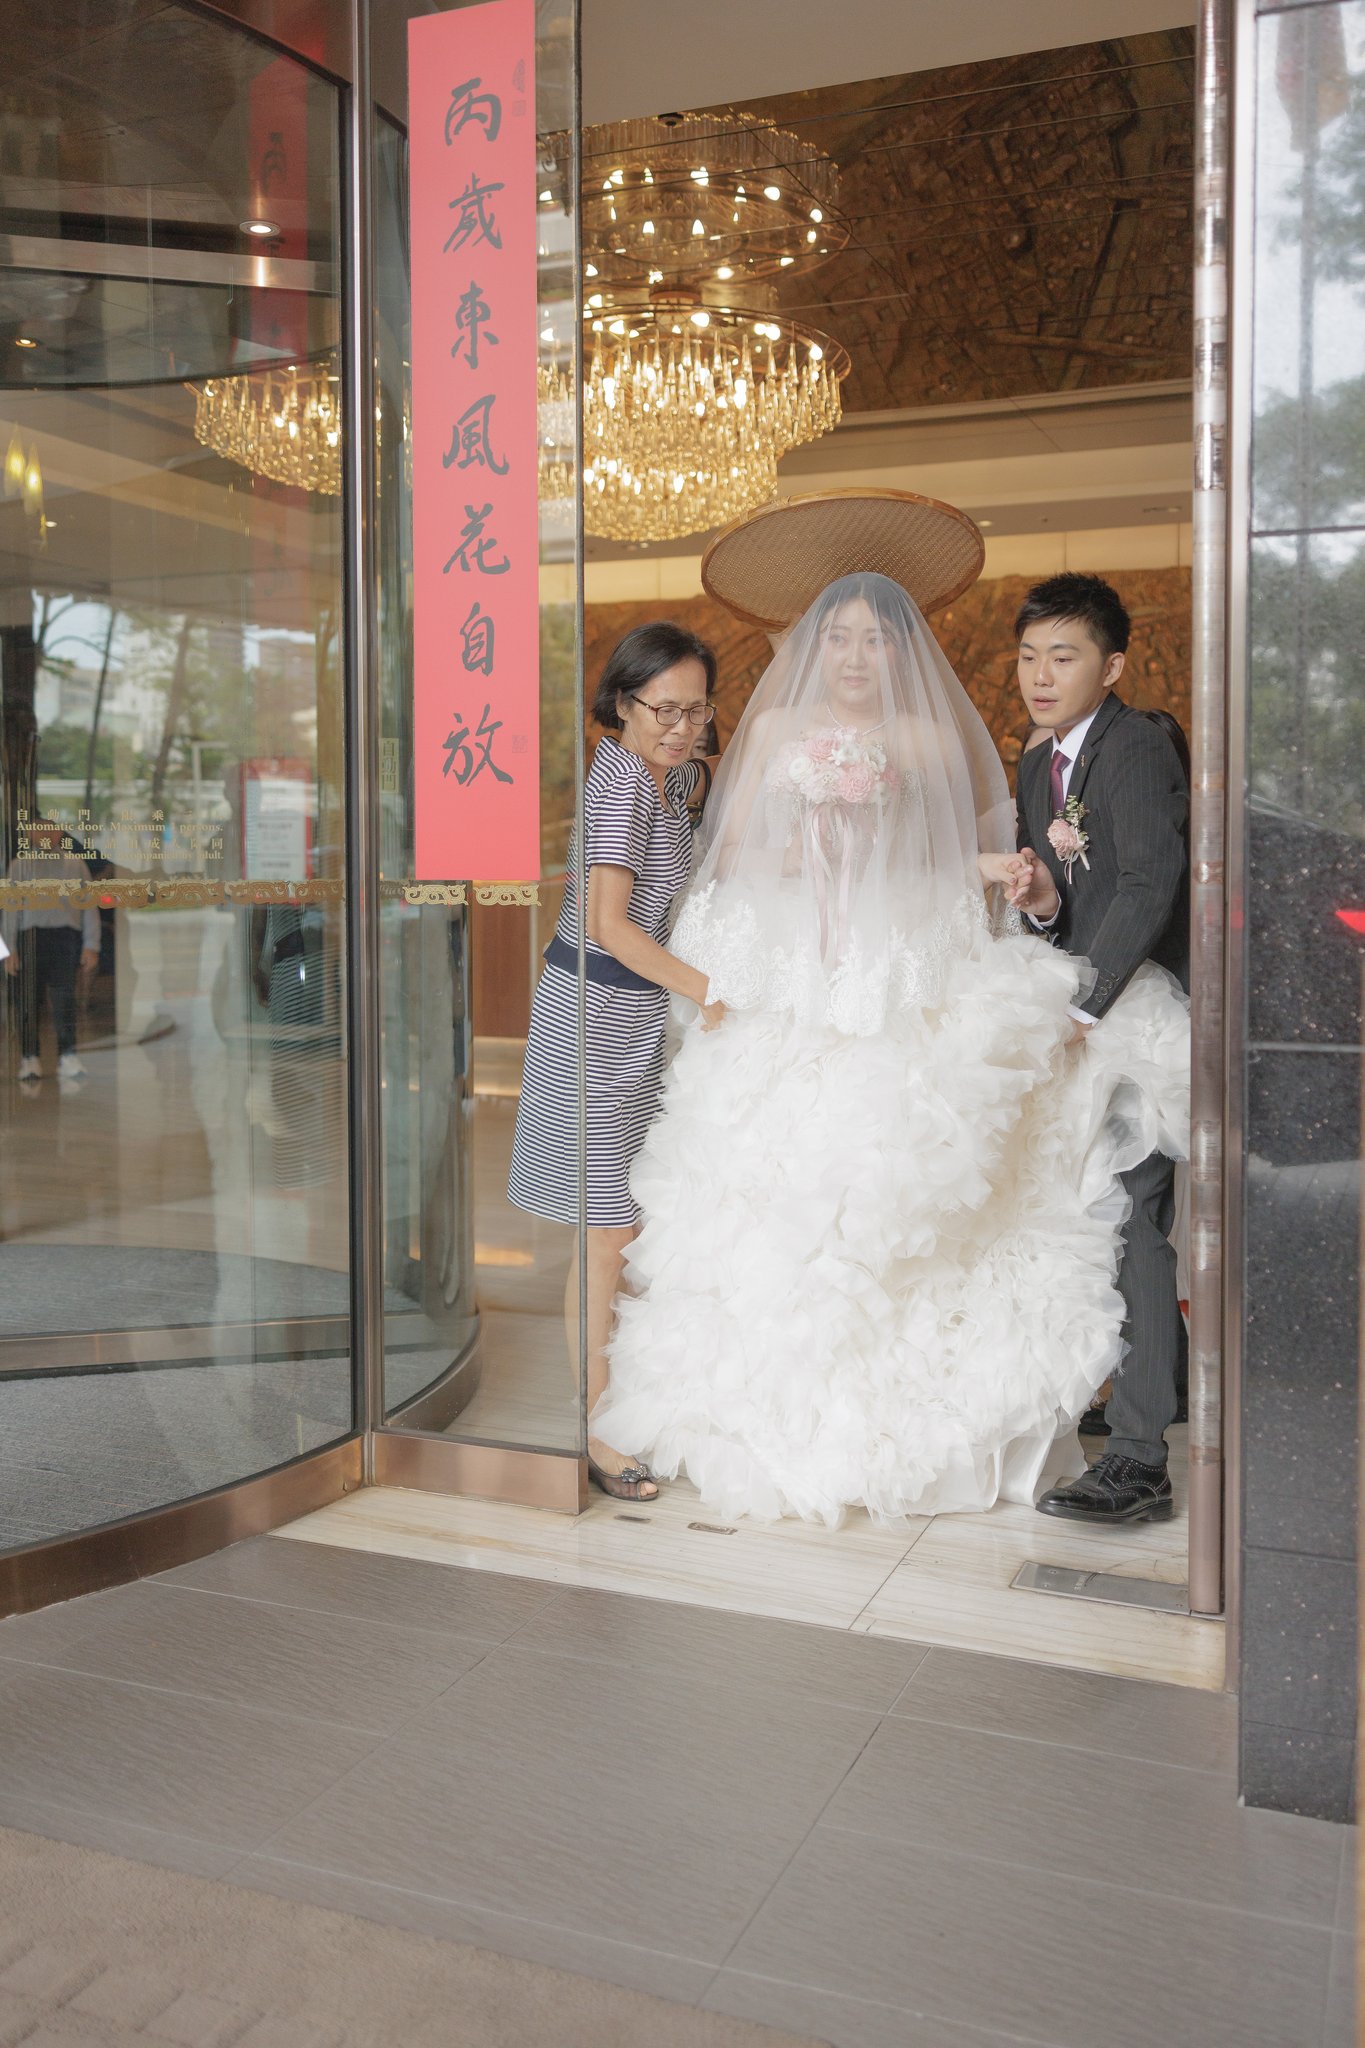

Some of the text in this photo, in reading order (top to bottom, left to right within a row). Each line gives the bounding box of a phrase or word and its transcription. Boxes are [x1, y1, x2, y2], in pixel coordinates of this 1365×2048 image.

[381, 740, 396, 791] 自動門
[16, 822, 75, 832] Automatic
[110, 822, 166, 832] Maximum
[16, 850, 60, 860] Children
[64, 850, 96, 860] should
[101, 850, 112, 860] be
